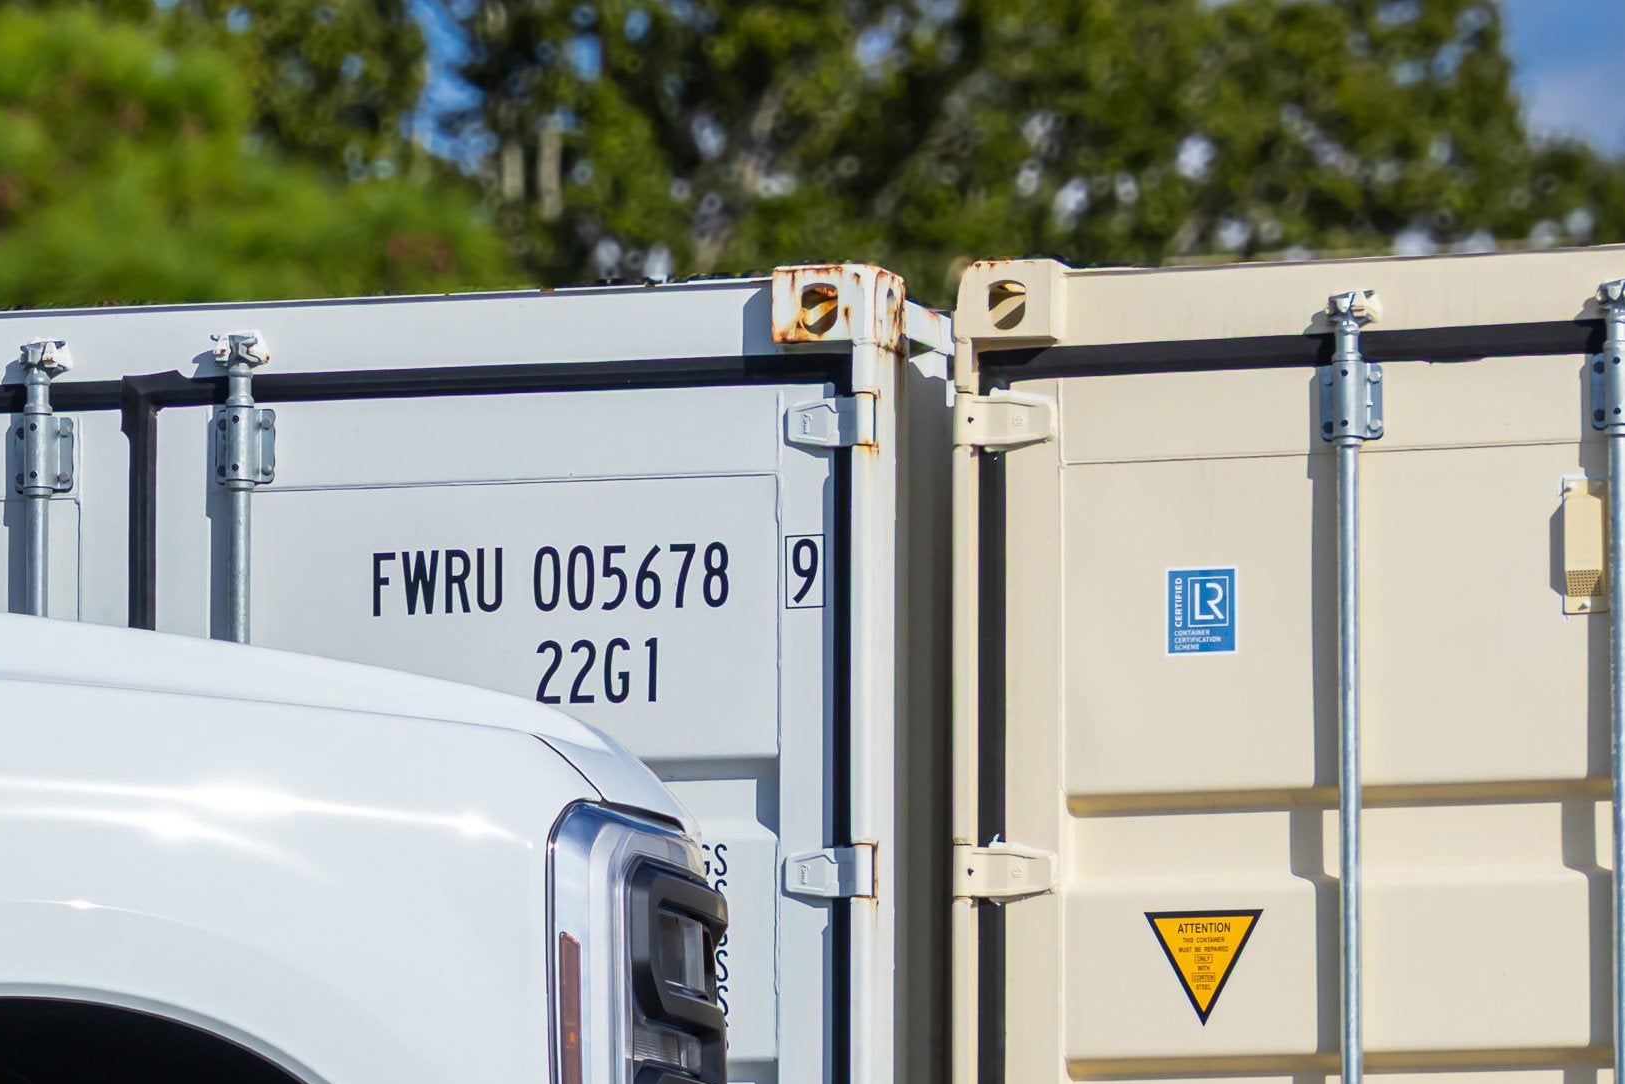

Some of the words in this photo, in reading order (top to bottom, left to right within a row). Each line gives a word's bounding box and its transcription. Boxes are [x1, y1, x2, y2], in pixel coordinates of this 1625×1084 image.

[373, 547, 503, 617] FWRU
[533, 541, 729, 613] 005678
[792, 538, 818, 604] 9
[1174, 577, 1183, 628] CERTIFIED
[1194, 582, 1225, 620] LR
[1174, 629, 1210, 637] CONTAINER
[1174, 636, 1222, 644] CERTIFICATION
[536, 637, 658, 704] 22G1
[1177, 922, 1231, 934] ATTENTION
